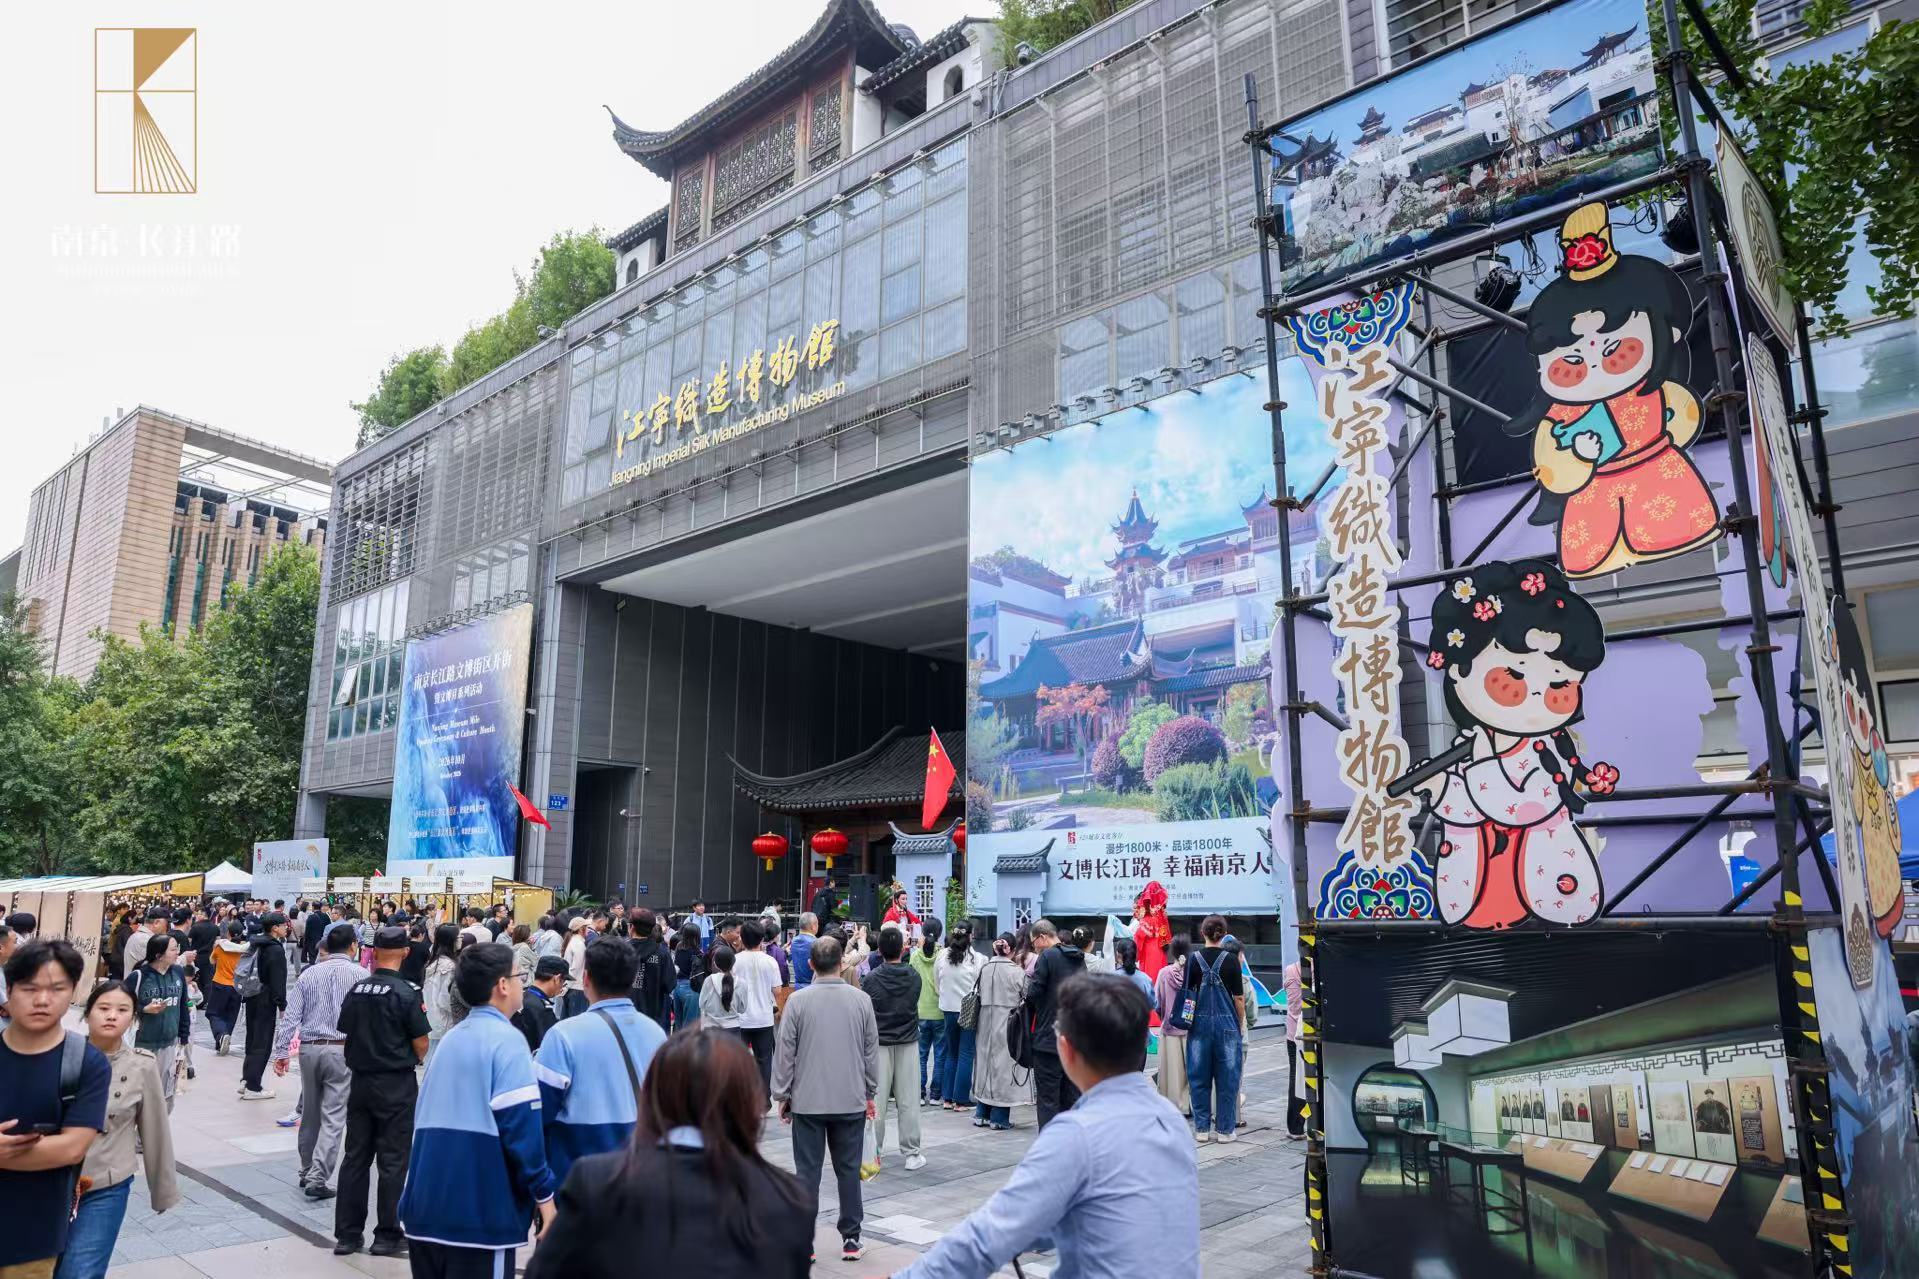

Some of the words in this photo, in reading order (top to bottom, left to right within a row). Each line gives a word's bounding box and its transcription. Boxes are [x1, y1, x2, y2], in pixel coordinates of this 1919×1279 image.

[609, 460, 651, 486] Jiangning
[653, 440, 691, 469] Imperial
[692, 434, 710, 453] Silk
[712, 404, 789, 445] Manufacturing
[792, 380, 846, 413] Museum
[1057, 856, 1152, 881] 文博长江路
[1163, 851, 1271, 878] 幸福南京人
